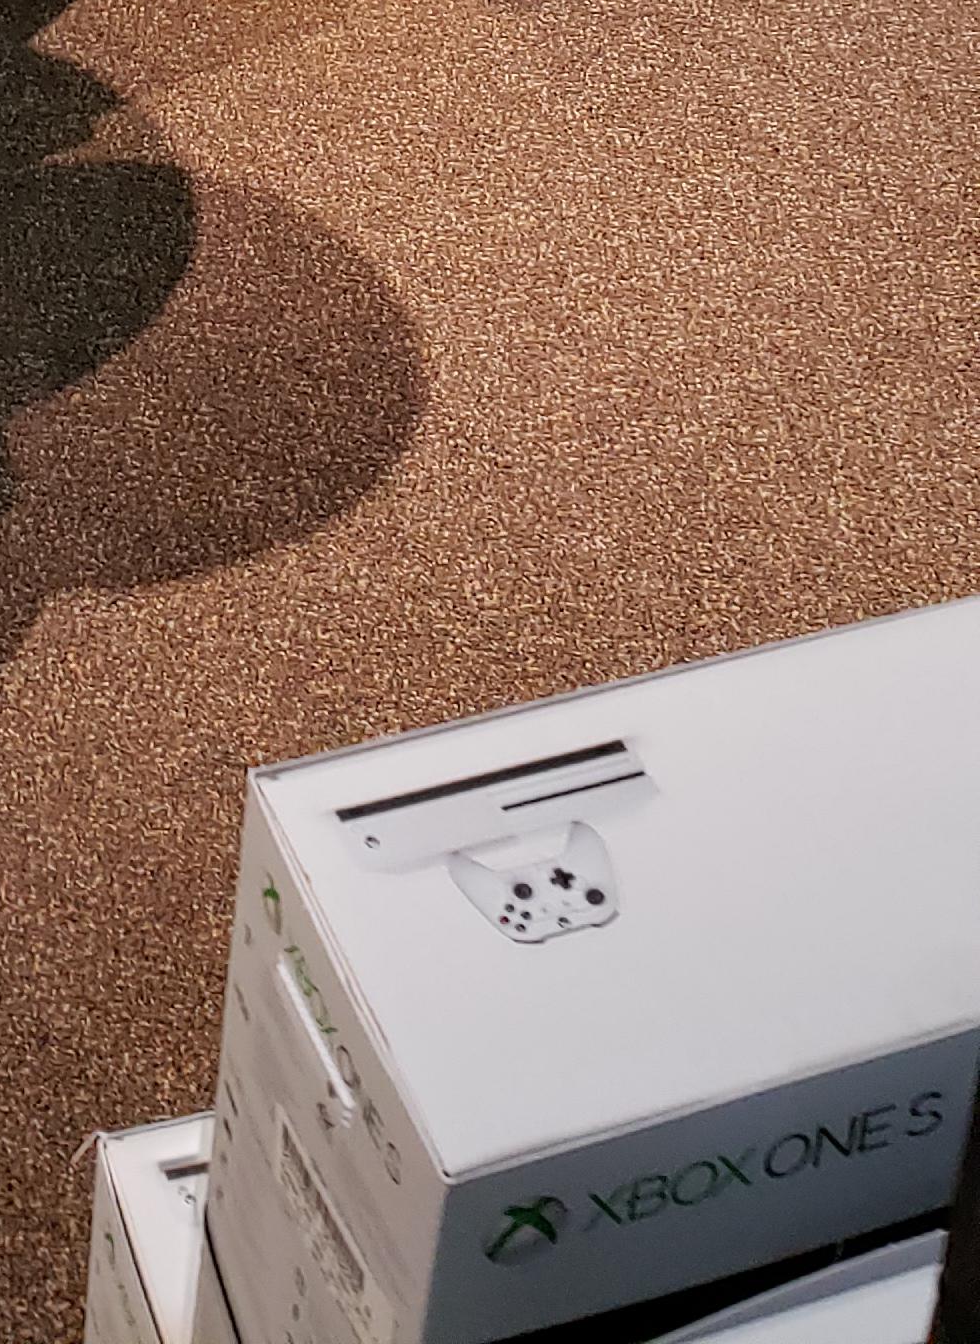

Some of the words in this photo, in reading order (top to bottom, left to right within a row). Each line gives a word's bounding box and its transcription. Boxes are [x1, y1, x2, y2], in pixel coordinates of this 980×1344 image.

[582, 1145, 759, 1234] XBOX
[763, 1104, 897, 1179] ONE
[905, 1090, 943, 1138] S
